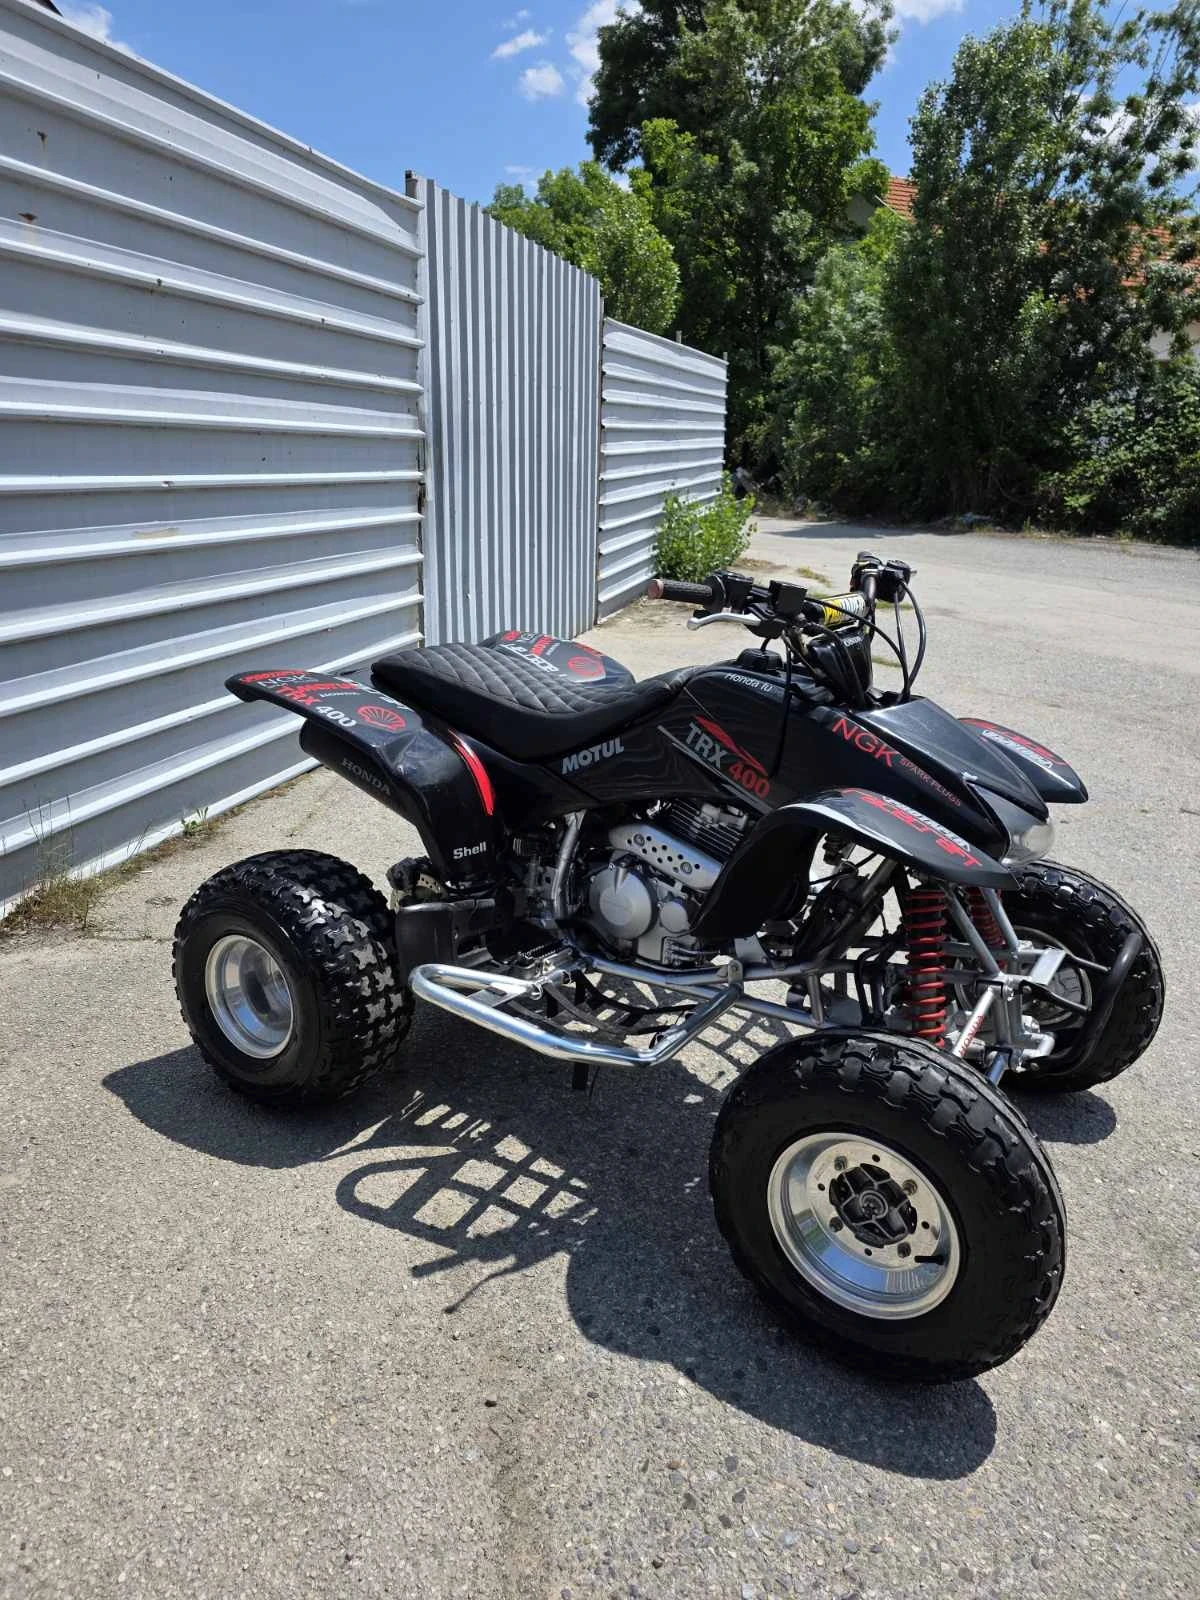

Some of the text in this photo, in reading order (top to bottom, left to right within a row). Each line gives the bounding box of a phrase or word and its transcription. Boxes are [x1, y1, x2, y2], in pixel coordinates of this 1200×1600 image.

[724, 673, 760, 688] Honda
[315, 705, 357, 727] 400
[561, 736, 625, 775] MOTUL
[686, 721, 771, 799] TRX 400
[831, 717, 901, 769] NGK
[341, 757, 392, 797] HONDA
[452, 840, 487, 860] Shell
